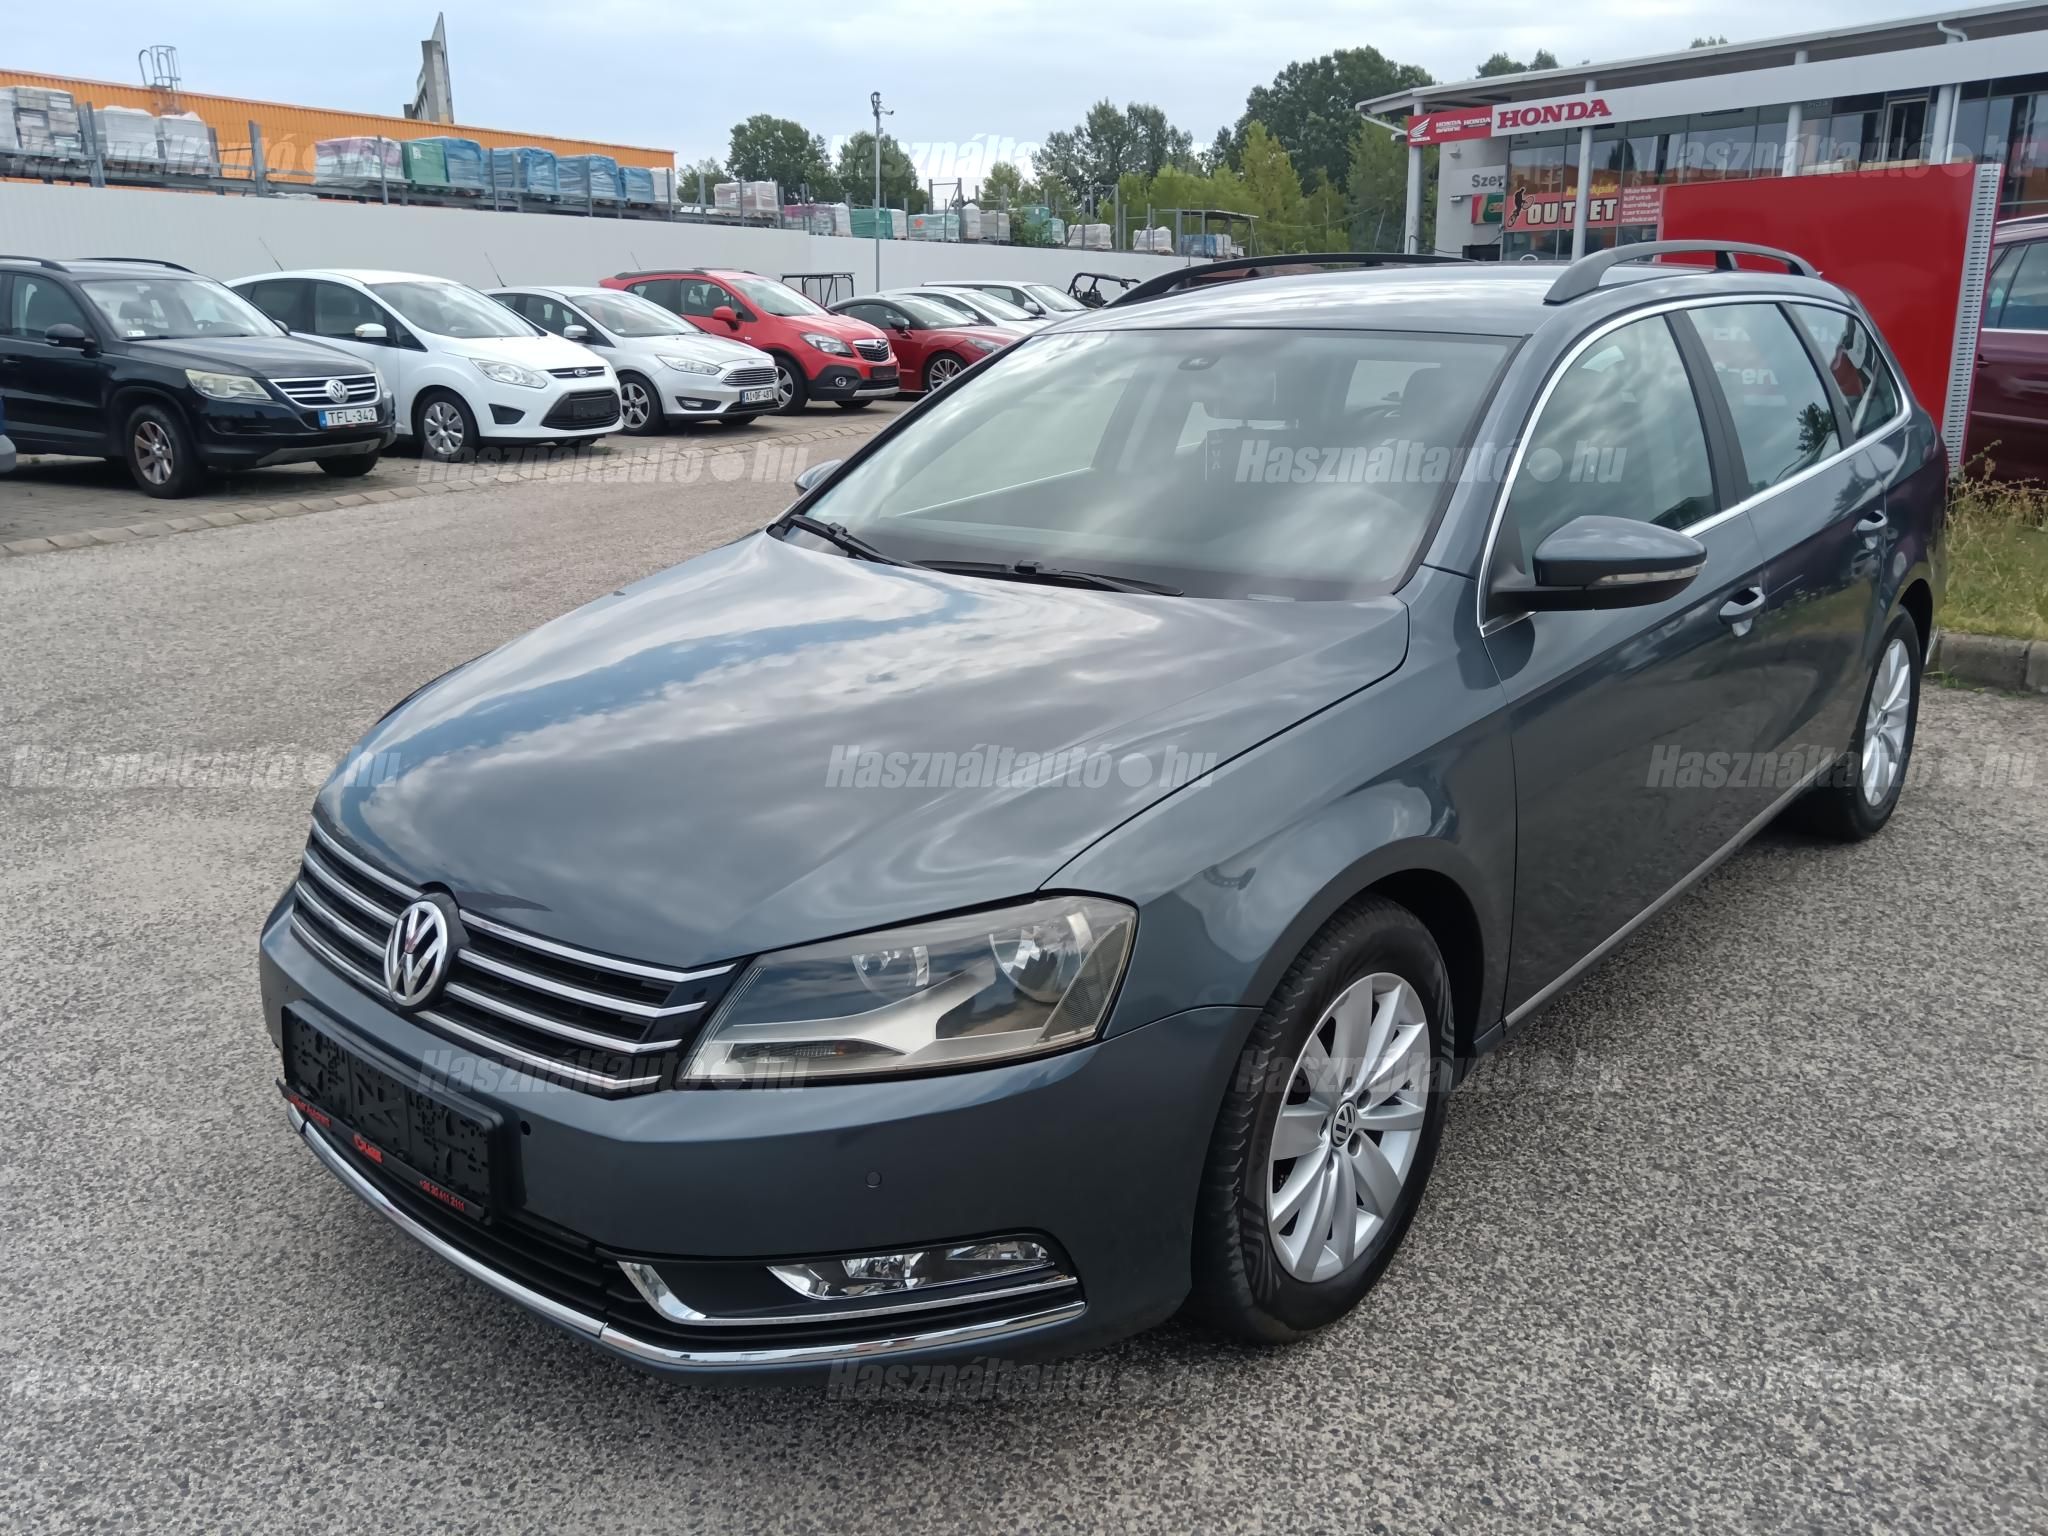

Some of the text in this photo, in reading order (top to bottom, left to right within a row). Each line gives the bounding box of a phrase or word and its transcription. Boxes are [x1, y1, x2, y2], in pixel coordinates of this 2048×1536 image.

[1496, 98, 1612, 129] HONDA
[1527, 198, 1618, 226] OUTET
[328, 409, 375, 425] TFL-342
